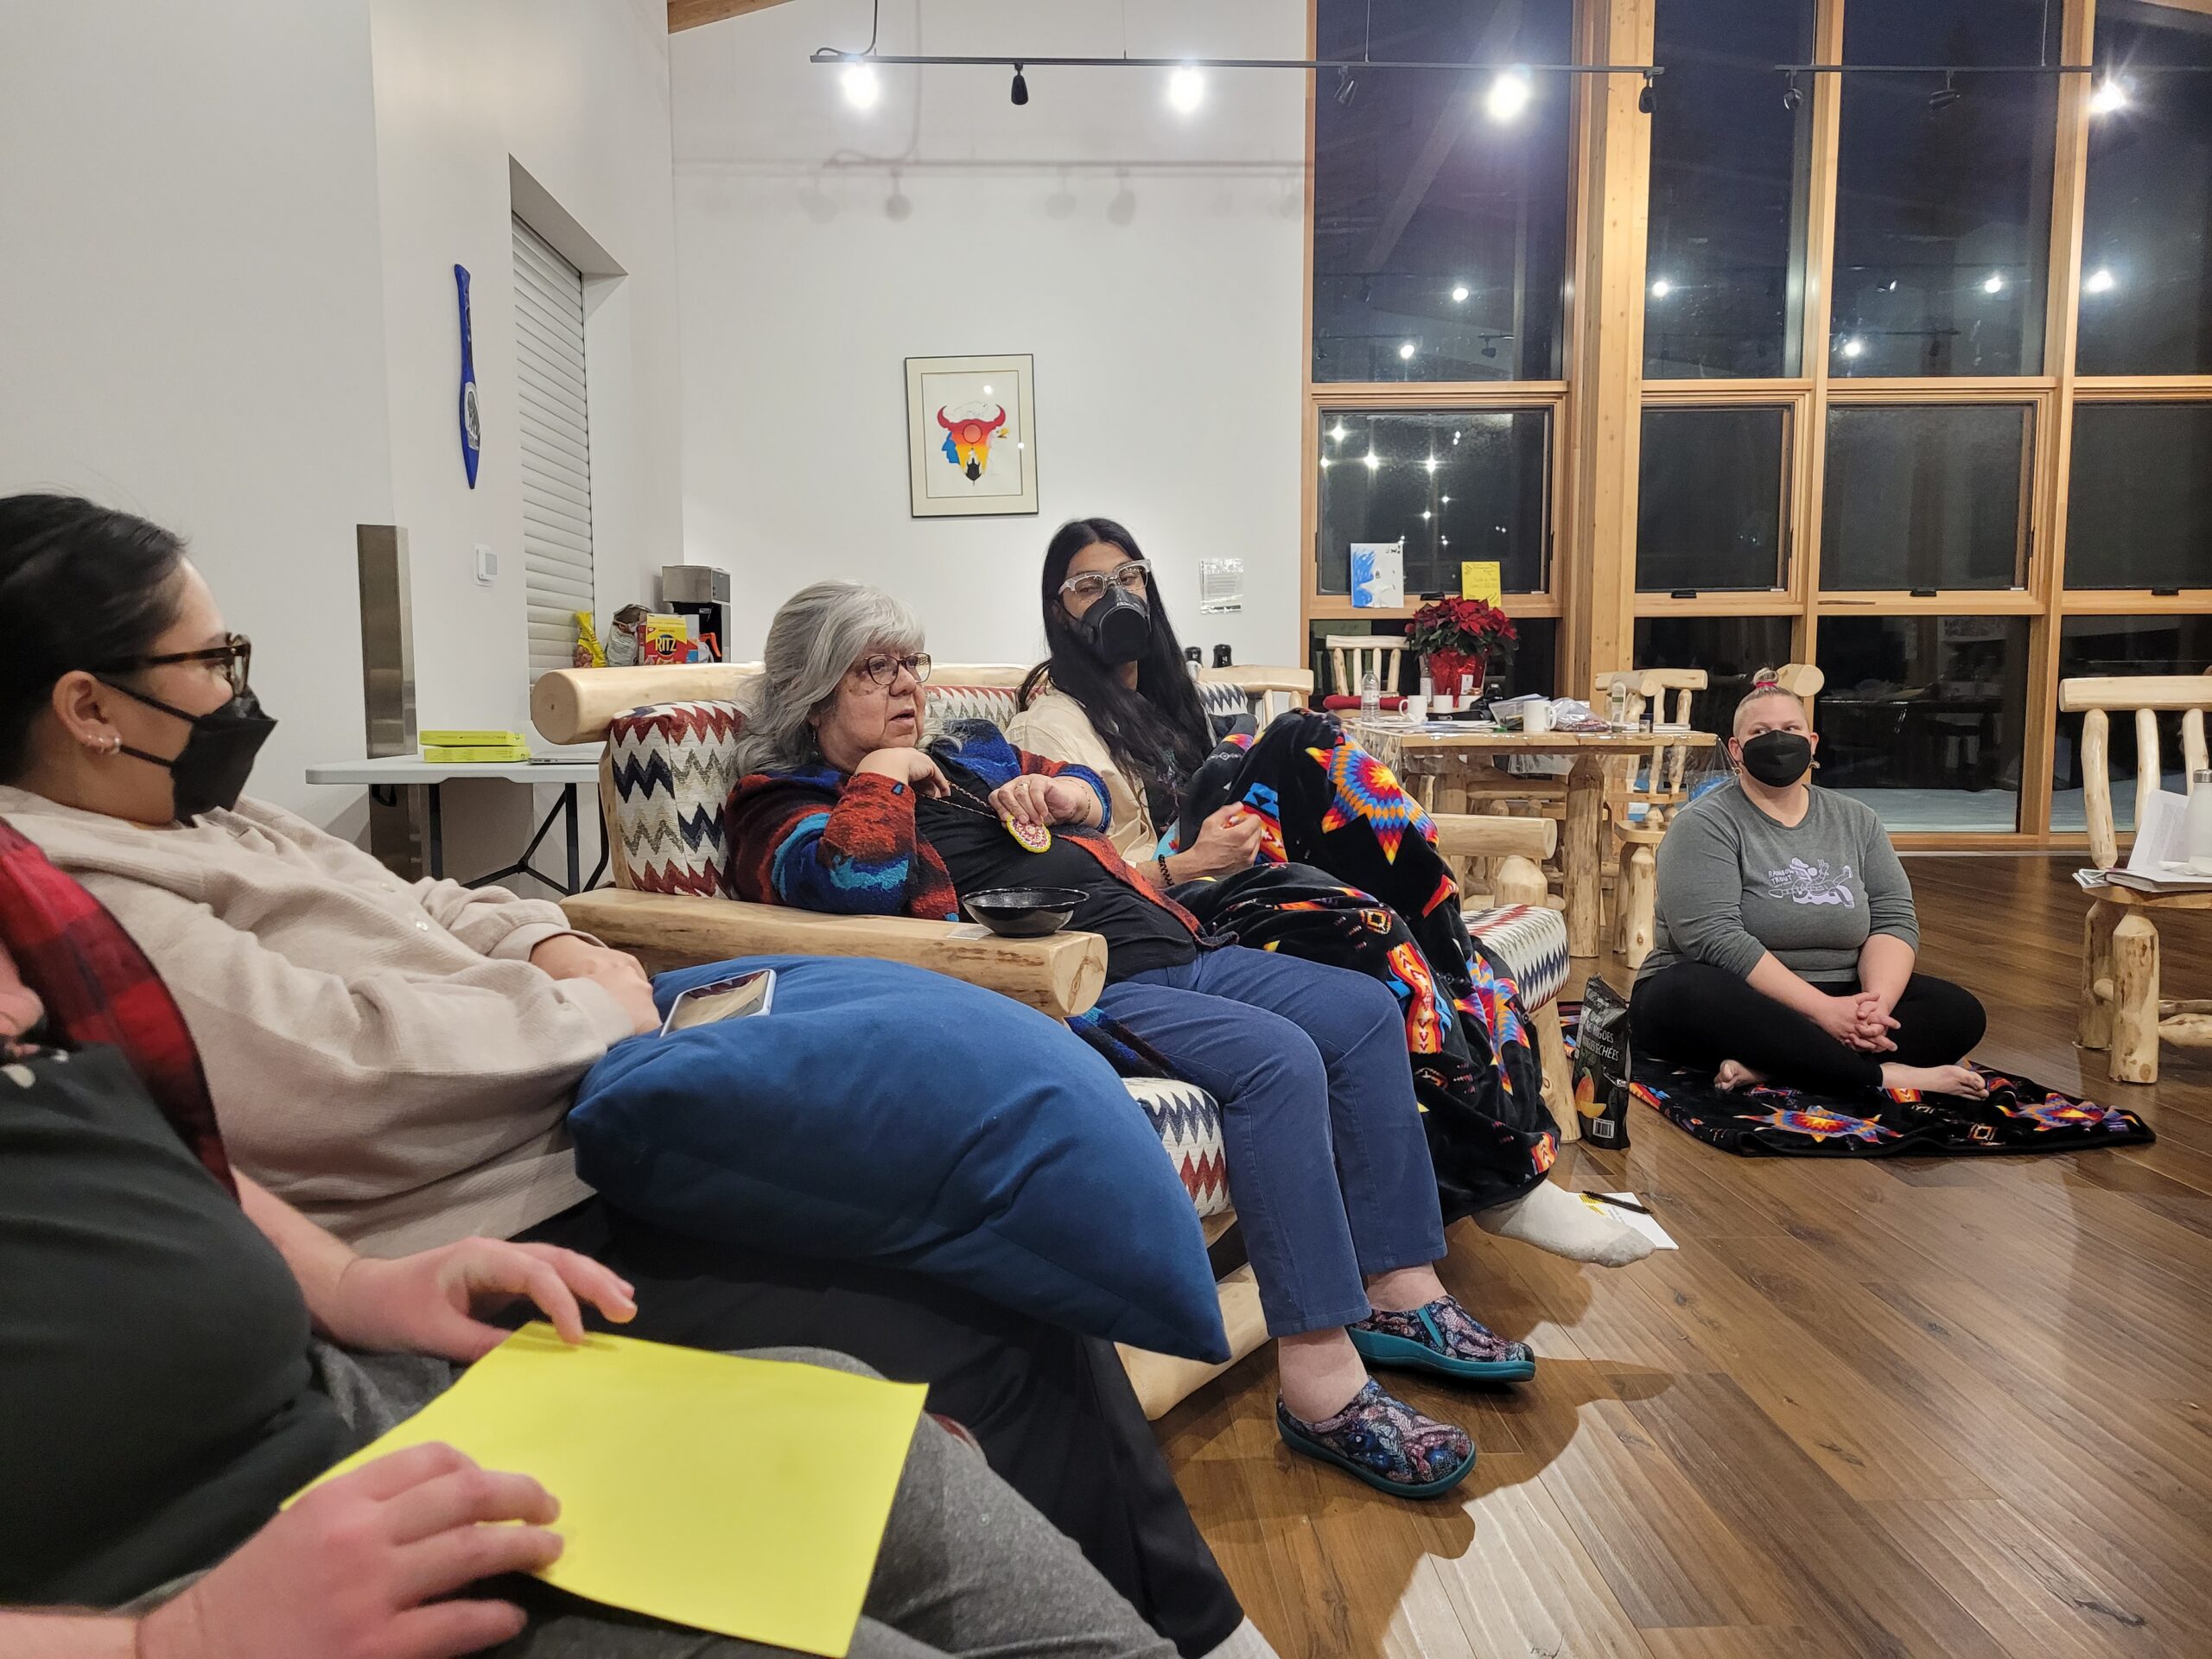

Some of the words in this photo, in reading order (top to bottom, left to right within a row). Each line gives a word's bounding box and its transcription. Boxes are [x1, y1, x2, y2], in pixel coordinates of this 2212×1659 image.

[655, 637, 677, 652] RITZ
[1768, 868, 1795, 879] RAINBOW
[1770, 874, 1792, 885] TROUT
